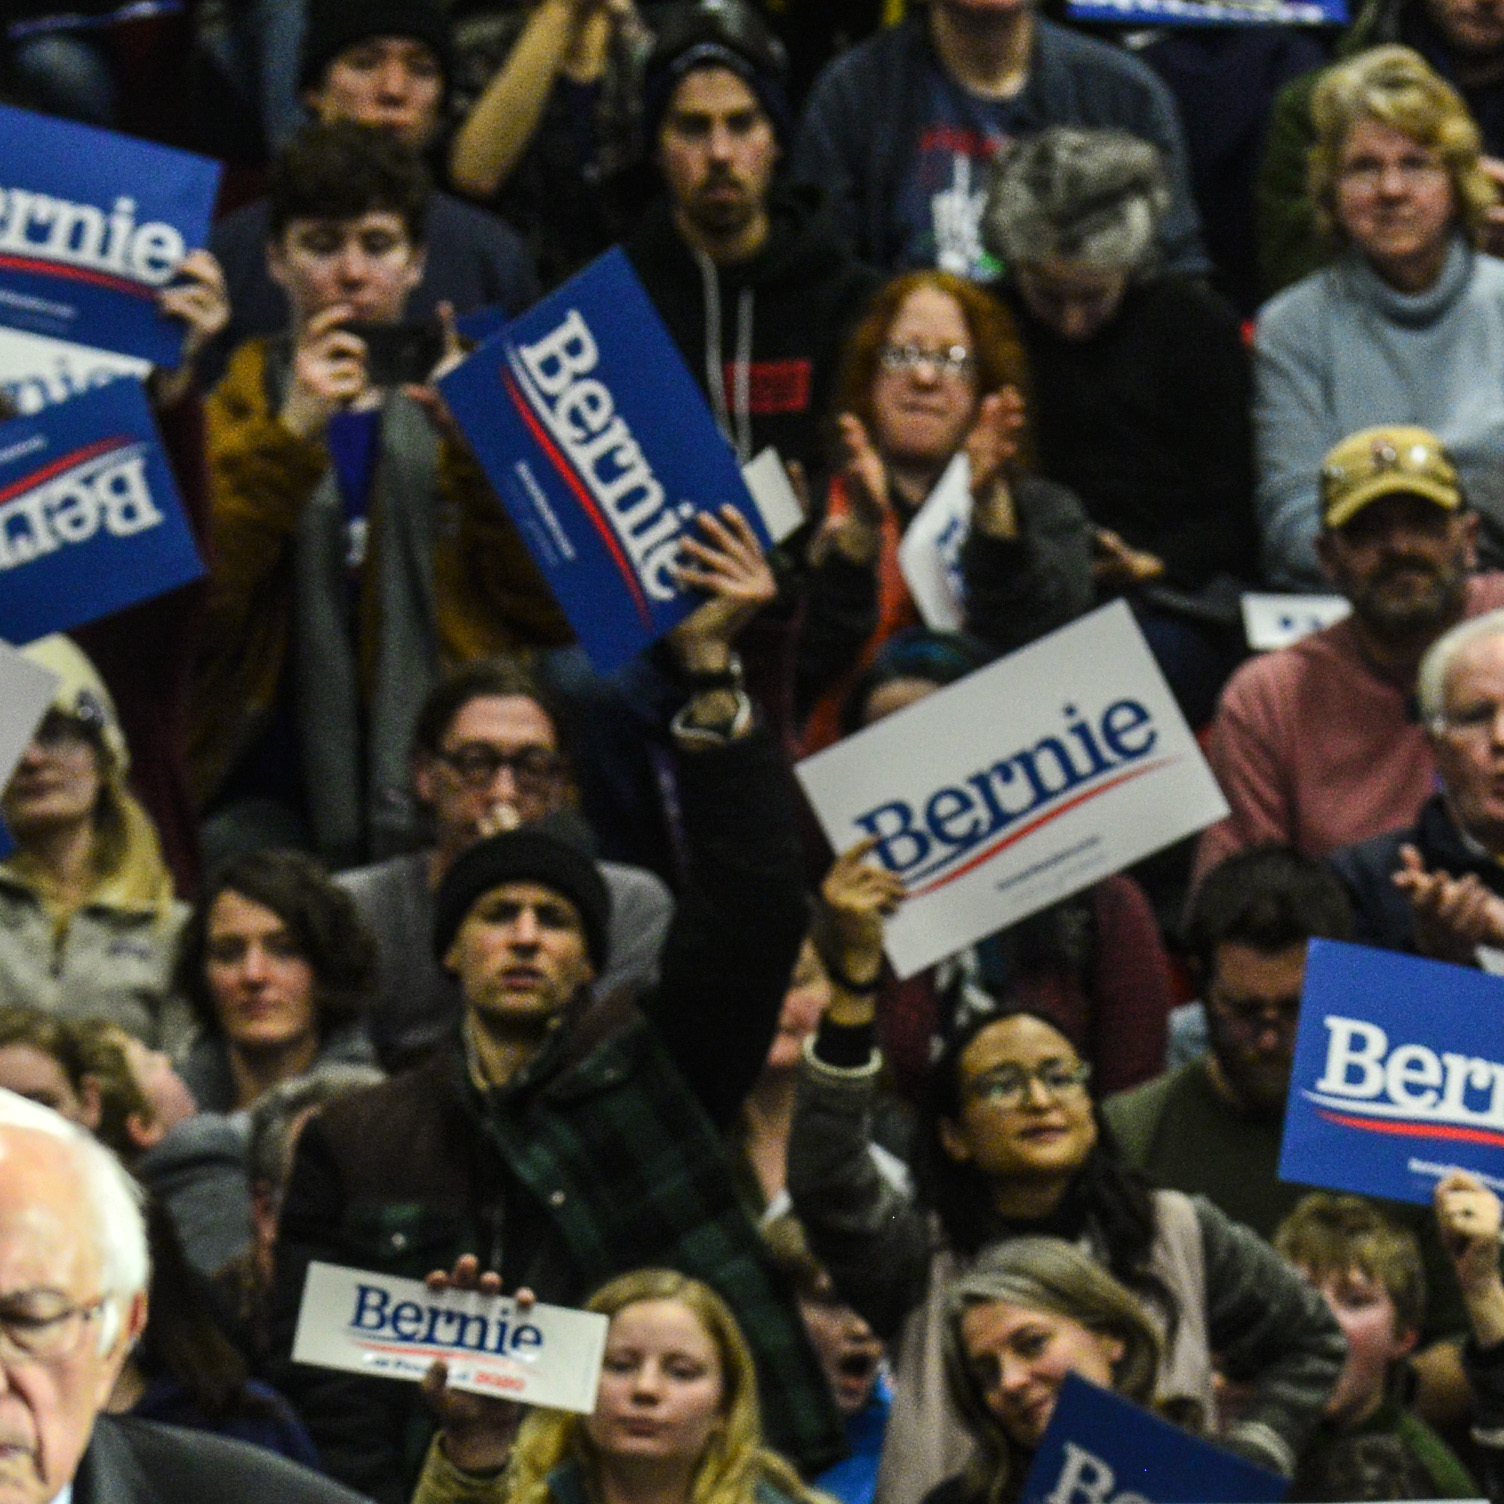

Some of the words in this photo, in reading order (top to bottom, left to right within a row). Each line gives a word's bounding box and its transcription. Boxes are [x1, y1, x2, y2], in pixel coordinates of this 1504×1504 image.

[521, 309, 686, 601] Bernie
[852, 699, 1159, 874] Bernie
[349, 1284, 543, 1356] Bernie
